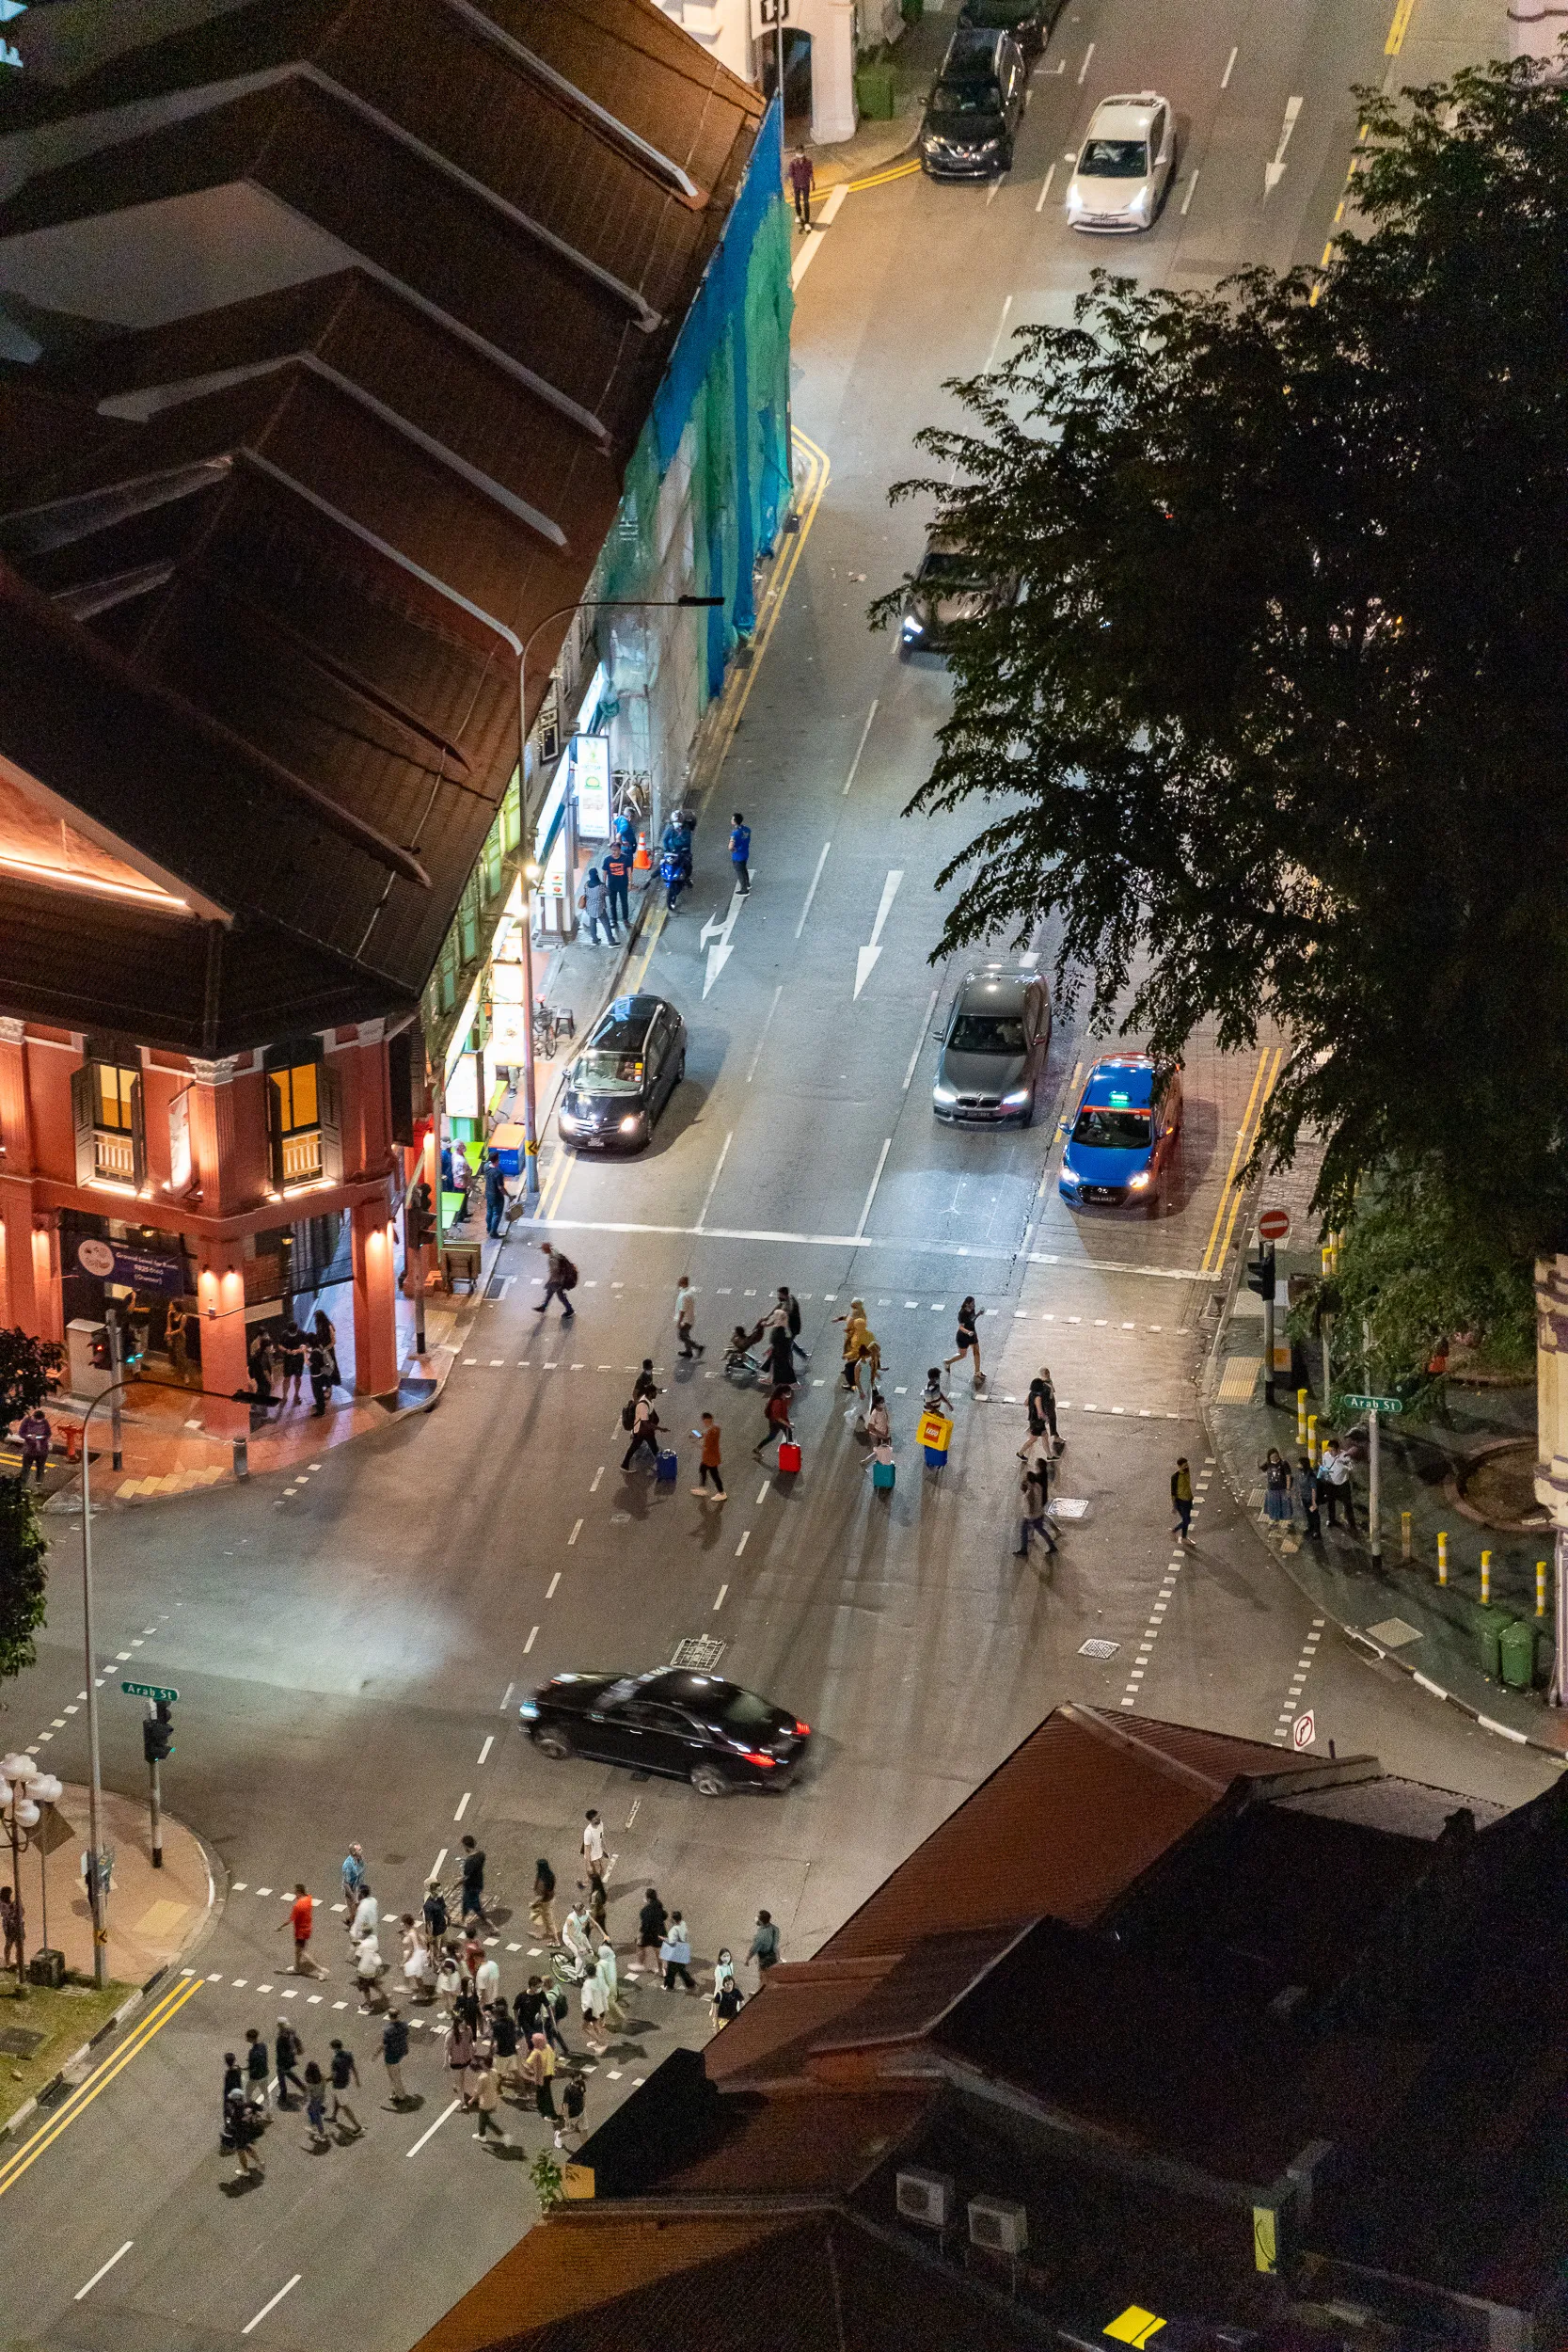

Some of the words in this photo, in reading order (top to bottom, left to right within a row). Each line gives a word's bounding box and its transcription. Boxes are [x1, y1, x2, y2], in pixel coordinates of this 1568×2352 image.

[1351, 1397, 1379, 1408] Arab
[1384, 1400, 1395, 1410] St
[926, 1427, 939, 1437] LEGO
[127, 1684, 155, 1697] Arab
[160, 1690, 172, 1700] St
